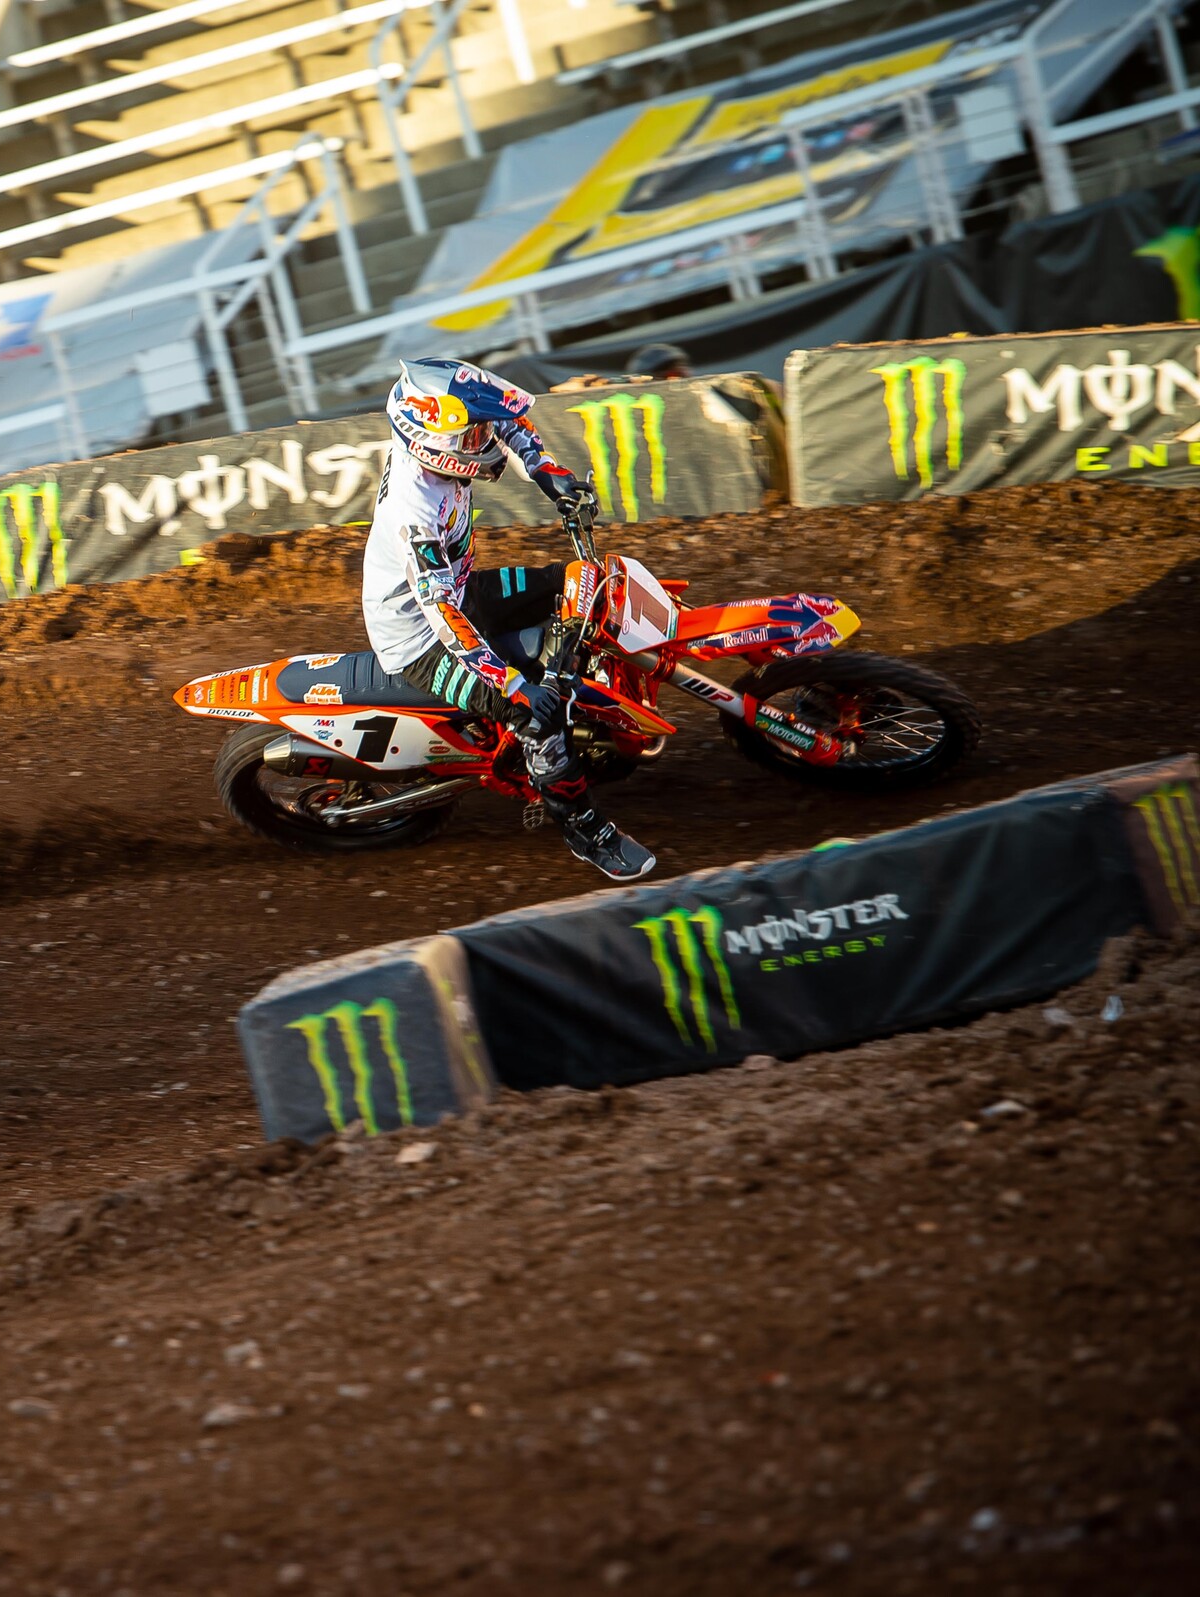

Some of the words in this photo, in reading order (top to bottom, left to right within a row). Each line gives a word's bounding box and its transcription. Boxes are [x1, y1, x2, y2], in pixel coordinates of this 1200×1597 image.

[408, 440, 444, 467] Red
[443, 458, 481, 477] Bull
[745, 628, 769, 645] Bull
[310, 684, 338, 696] KTM
[680, 678, 735, 702] WP
[207, 708, 255, 718] DUNLOP
[313, 718, 335, 727] AMA
[353, 715, 399, 762] 1
[767, 723, 813, 750] MOTOREX
[724, 894, 909, 955] MONSTER
[760, 935, 887, 972] ENERGY
